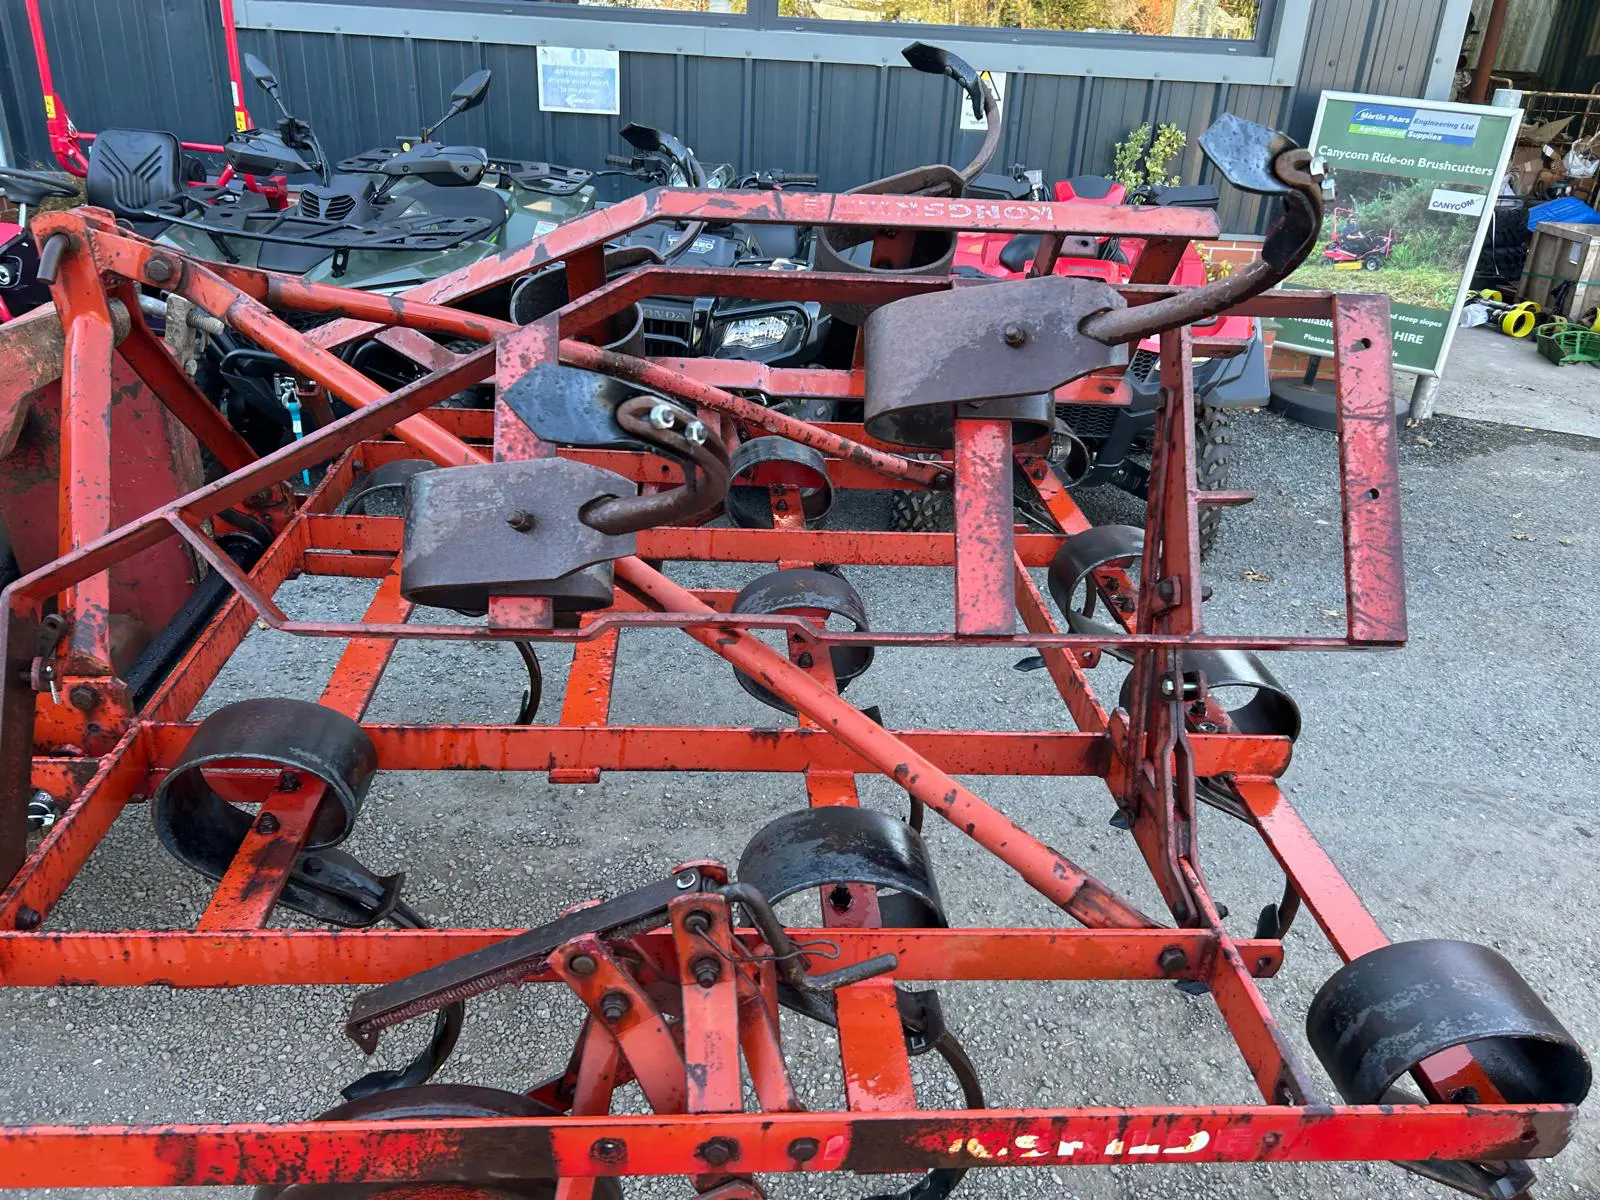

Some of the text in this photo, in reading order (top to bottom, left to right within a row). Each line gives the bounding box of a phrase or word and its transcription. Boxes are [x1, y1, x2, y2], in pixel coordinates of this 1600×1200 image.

[1360, 111, 1475, 131] Martin Pears Engineering Ltd
[1359, 125, 1442, 141] Agricultural Supplies
[1318, 145, 1494, 176] Canycom Ride-on Brushcutters
[1431, 198, 1475, 211] CANYCOM
[643, 308, 687, 320] ONDA
[1398, 315, 1419, 325] steep
[1419, 318, 1443, 329] slopes
[1303, 332, 1325, 344] Please
[1394, 330, 1425, 345] HIRE
